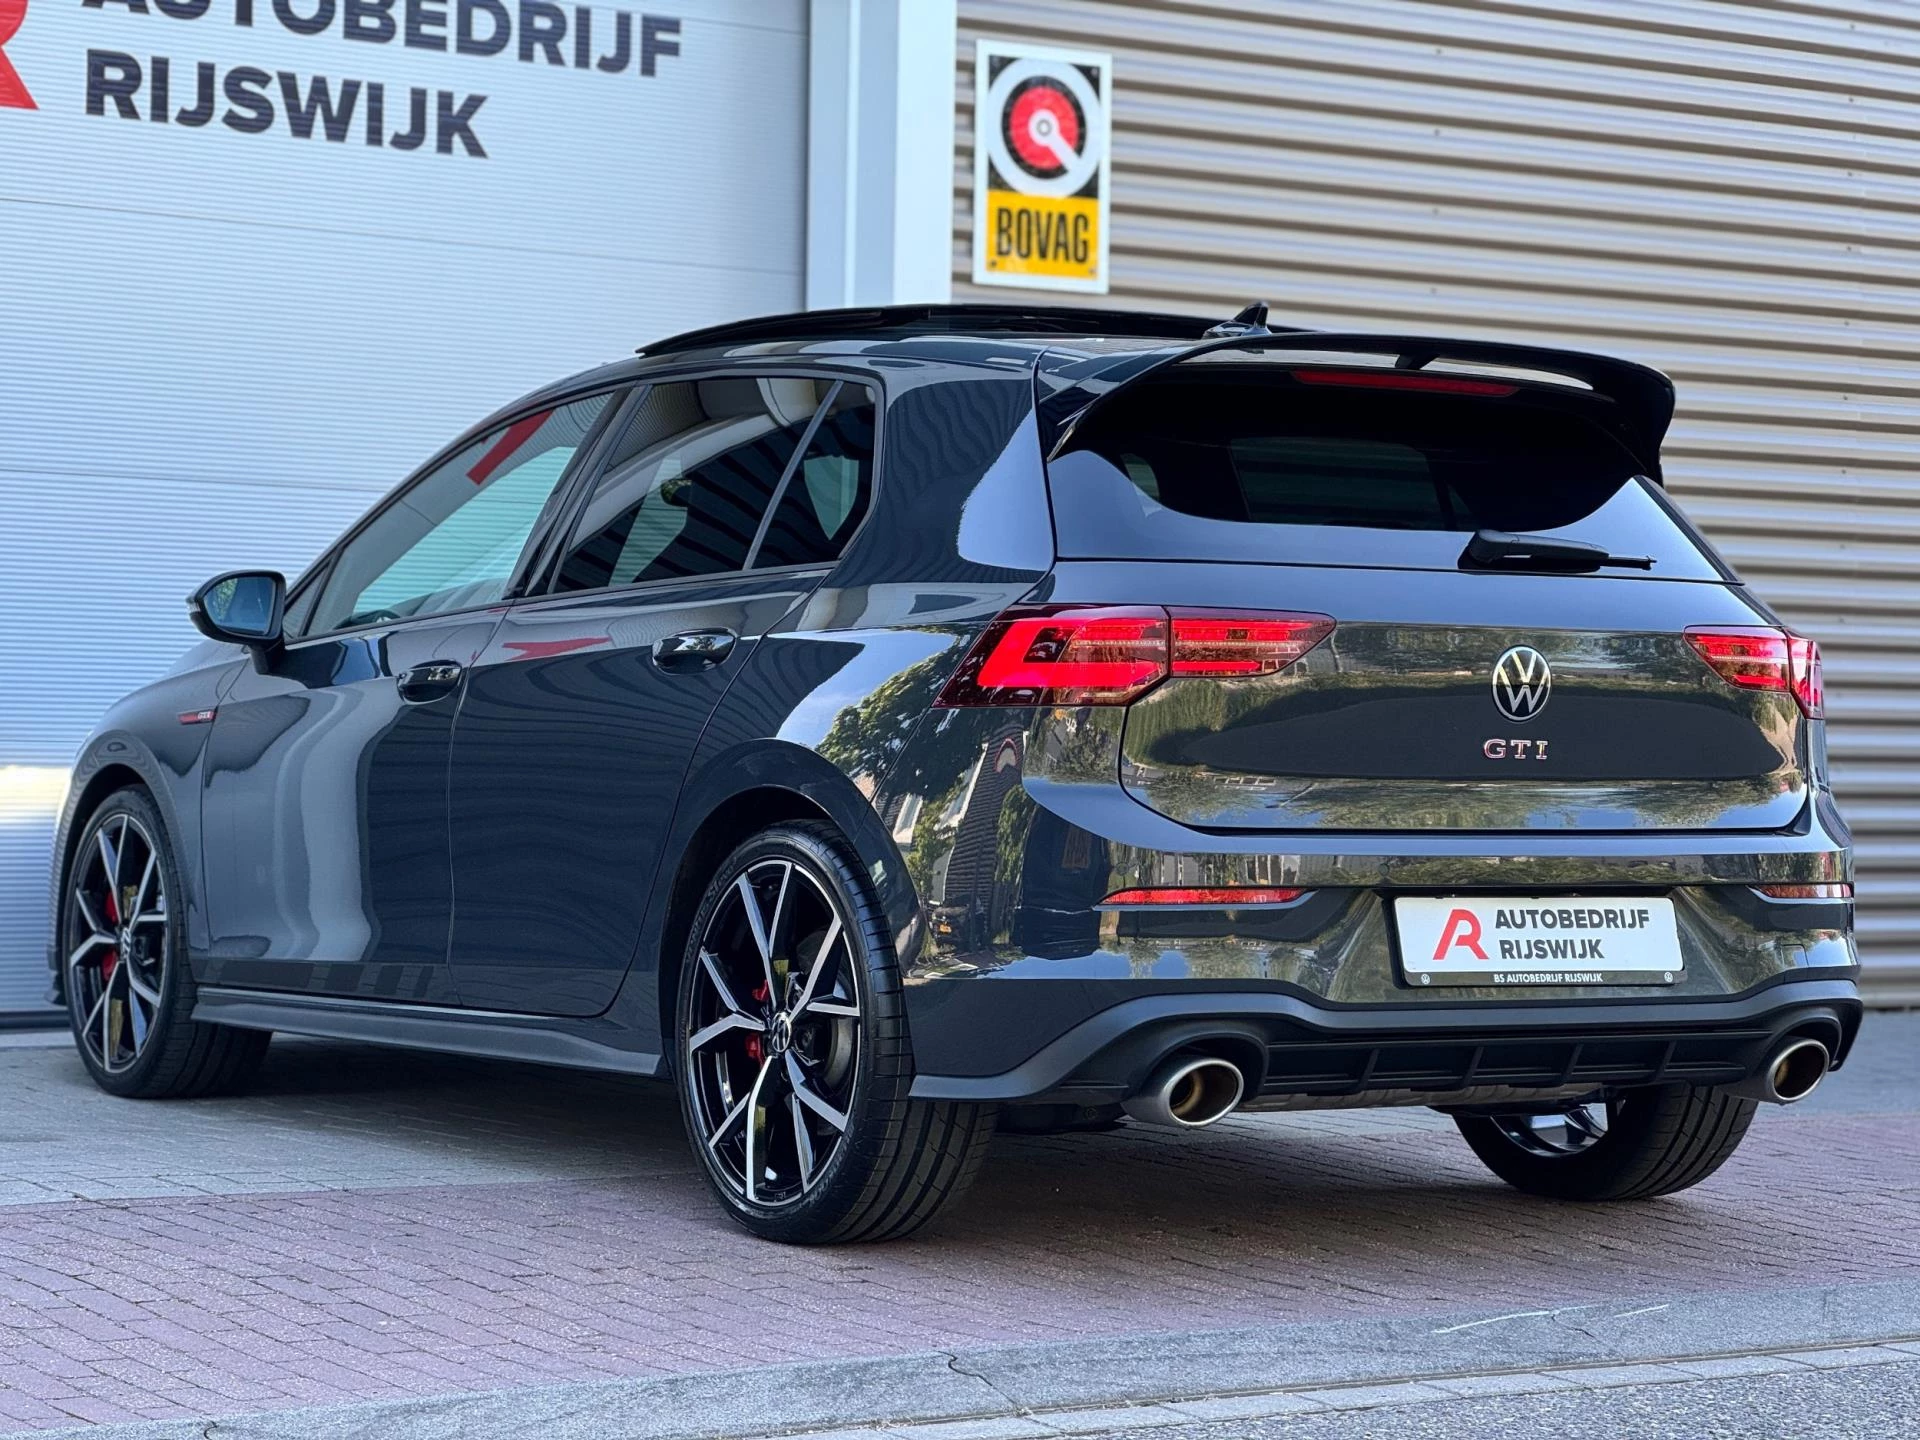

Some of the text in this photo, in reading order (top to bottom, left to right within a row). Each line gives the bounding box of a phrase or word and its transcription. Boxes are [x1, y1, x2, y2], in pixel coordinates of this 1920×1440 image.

[85, 48, 489, 159] RIJSWIJK
[996, 207, 1090, 264] BOVAG
[1483, 738, 1549, 760] GTI
[1495, 909, 1650, 929] AUTOBEDRIJF
[1499, 939, 1605, 960] RIJSWIJK
[1493, 973, 1604, 983] BS AUTOBEDRIJF RIJSWIJK
